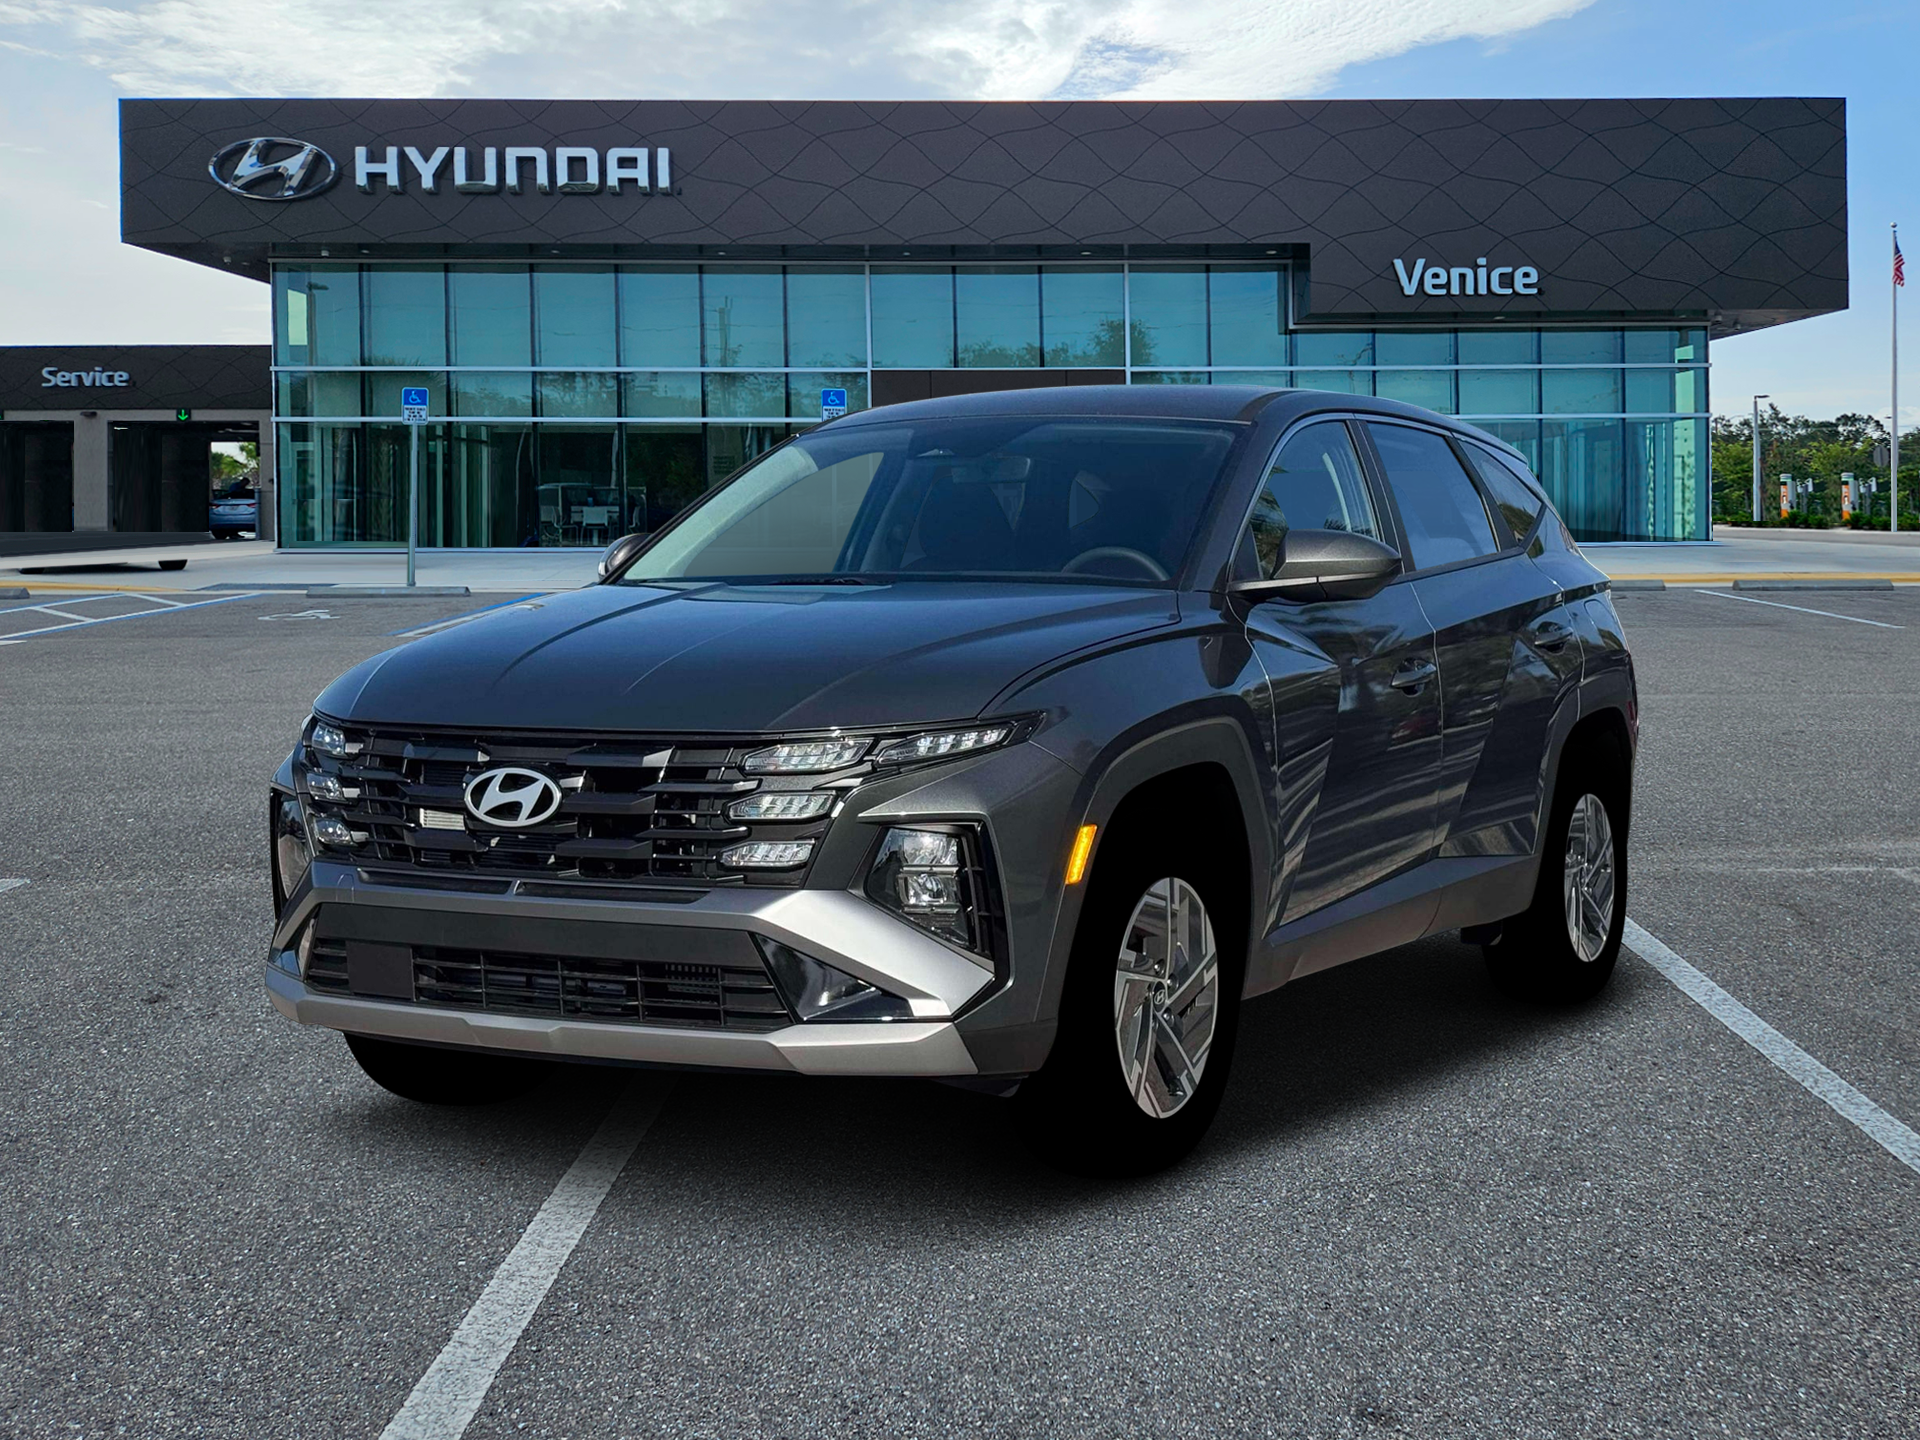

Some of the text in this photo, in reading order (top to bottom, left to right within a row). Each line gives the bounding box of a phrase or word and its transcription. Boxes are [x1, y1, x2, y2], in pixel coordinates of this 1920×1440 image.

[354, 146, 672, 195] HYUNDAI
[1392, 257, 1539, 296] Venice
[41, 366, 130, 387] Service
